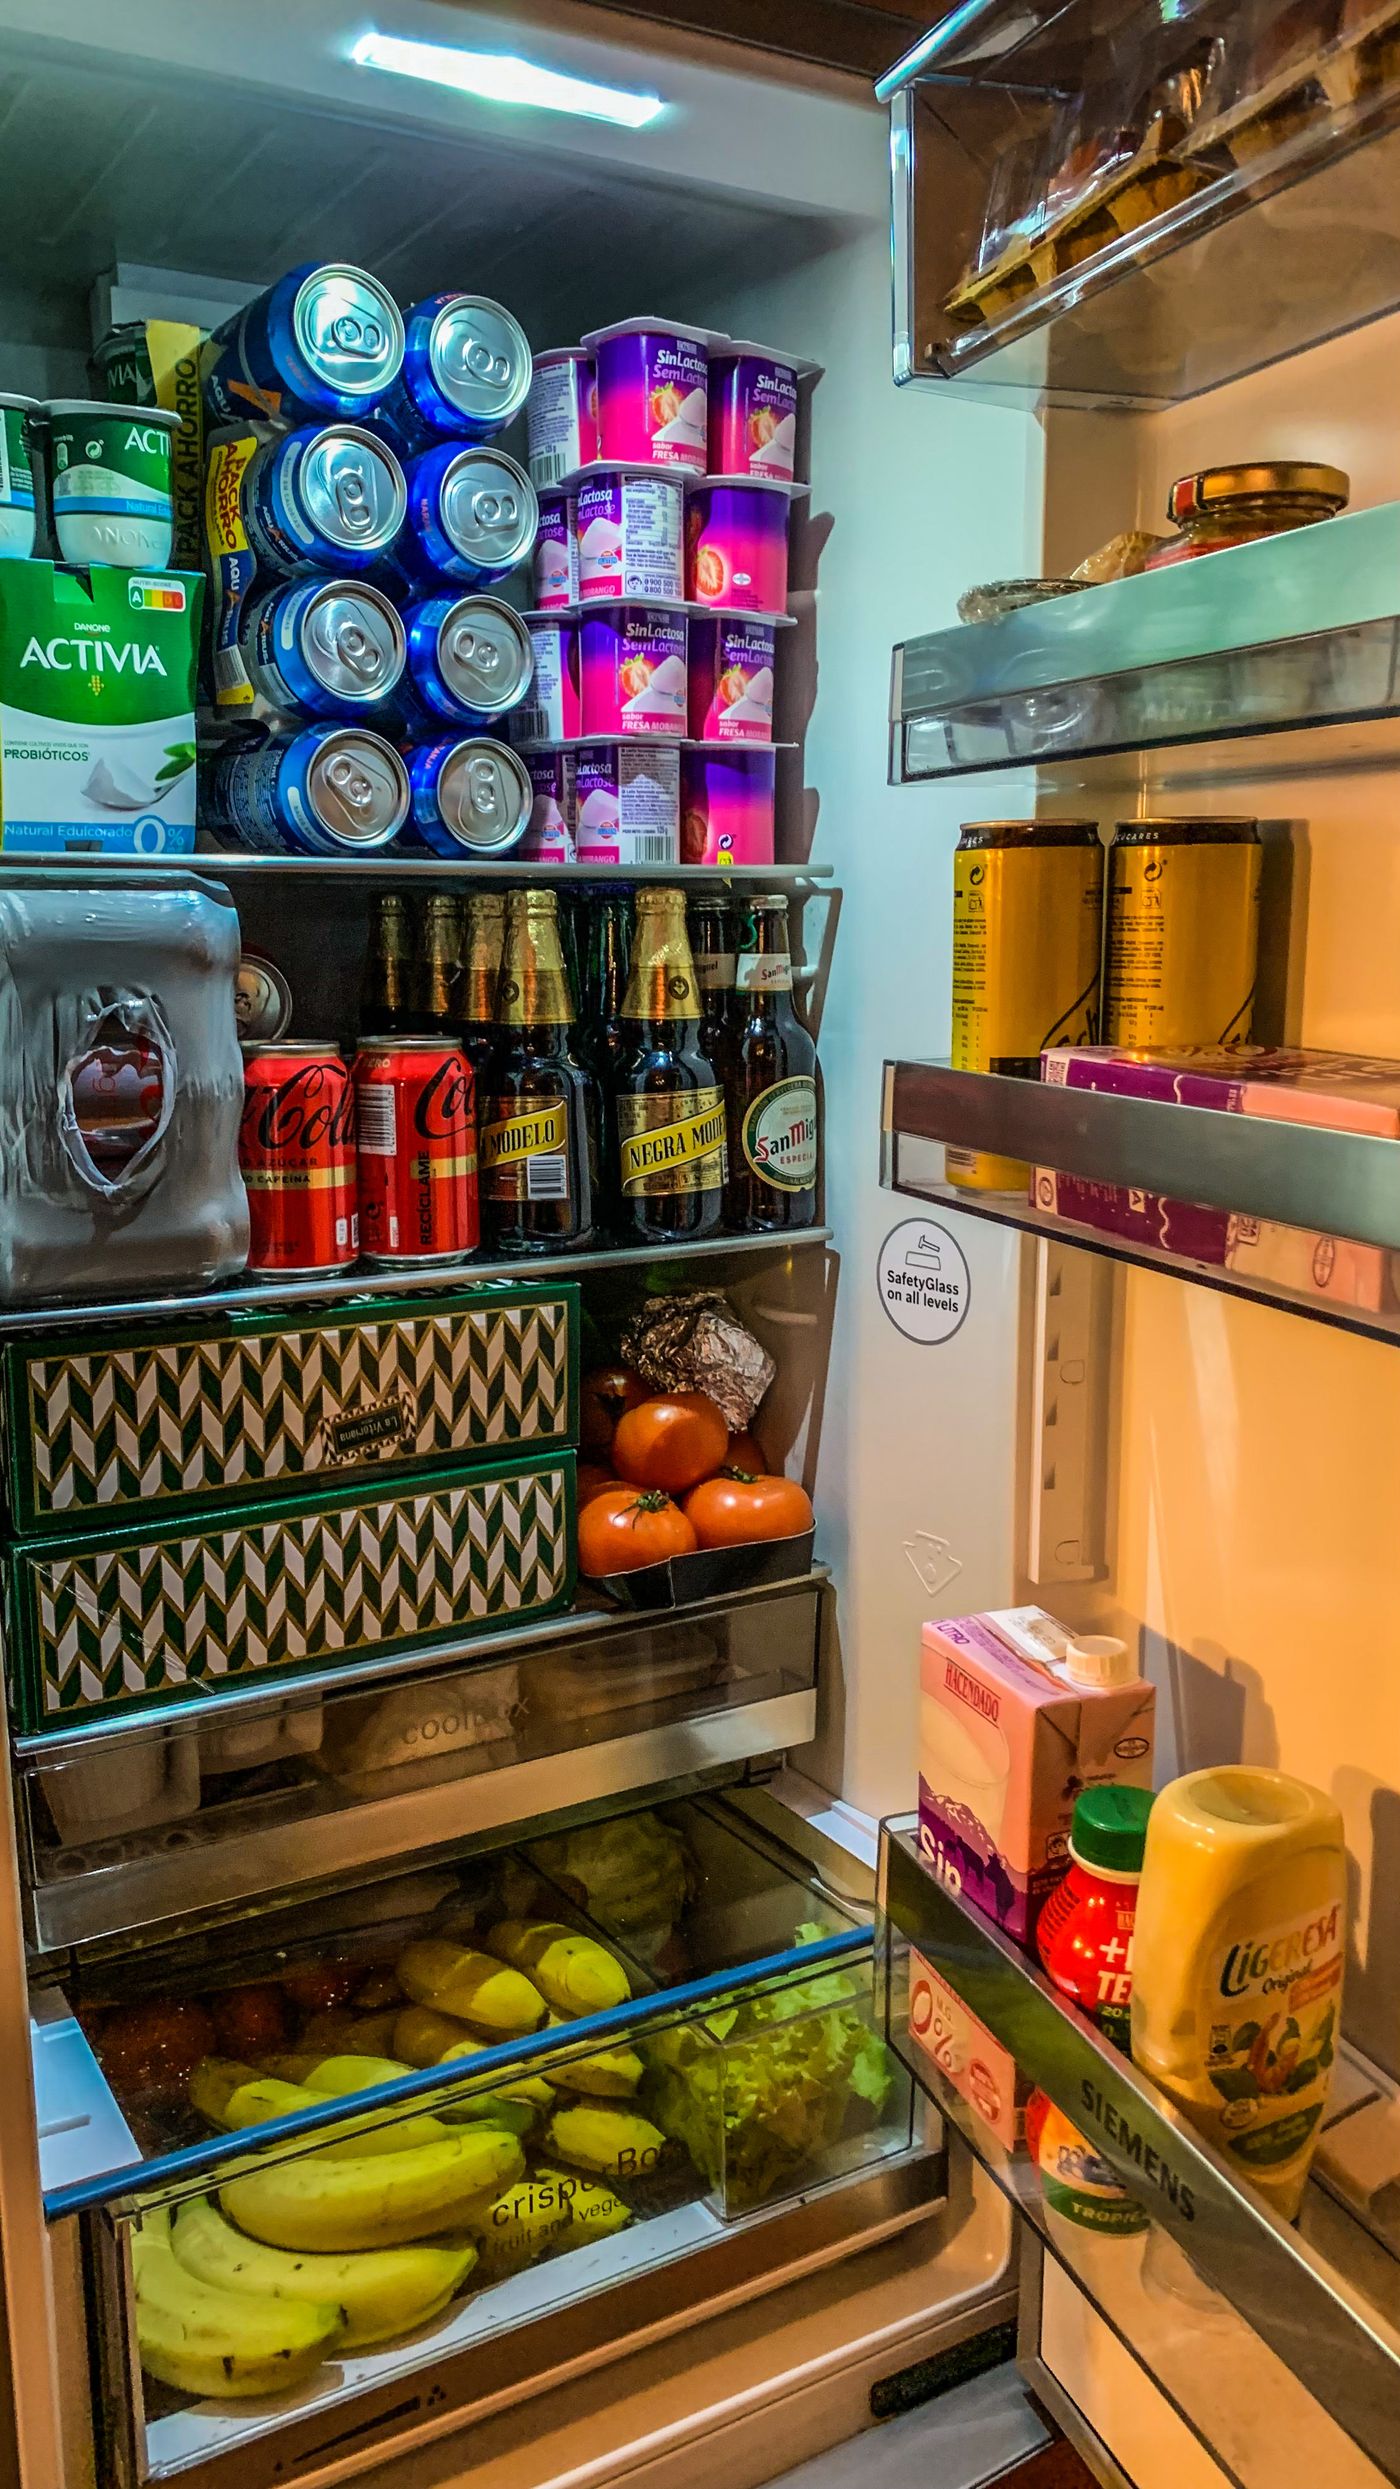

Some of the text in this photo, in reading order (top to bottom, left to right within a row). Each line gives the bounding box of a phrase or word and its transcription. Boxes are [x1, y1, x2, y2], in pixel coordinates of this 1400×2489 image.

[175, 359, 199, 480] AHORRO
[653, 450, 680, 461] FRESA
[218, 443, 238, 550] AHORRO
[132, 590, 142, 603] A
[20, 636, 167, 677] ACTIVIA
[622, 720, 650, 730] FRESA
[718, 727, 744, 737] FRESA
[4, 747, 89, 761] PROBIÓTICOS
[5, 825, 53, 836] Natural
[58, 825, 132, 838] Edulcorado
[490, 1119, 555, 1155] MODELO
[629, 1132, 687, 1170] NEGRA
[887, 1269, 959, 1295] SafetyGlass
[887, 1289, 959, 1313] on all levels
[945, 1659, 999, 1723] HACENDADO
[1080, 2078, 1196, 2222] SIEMENS
